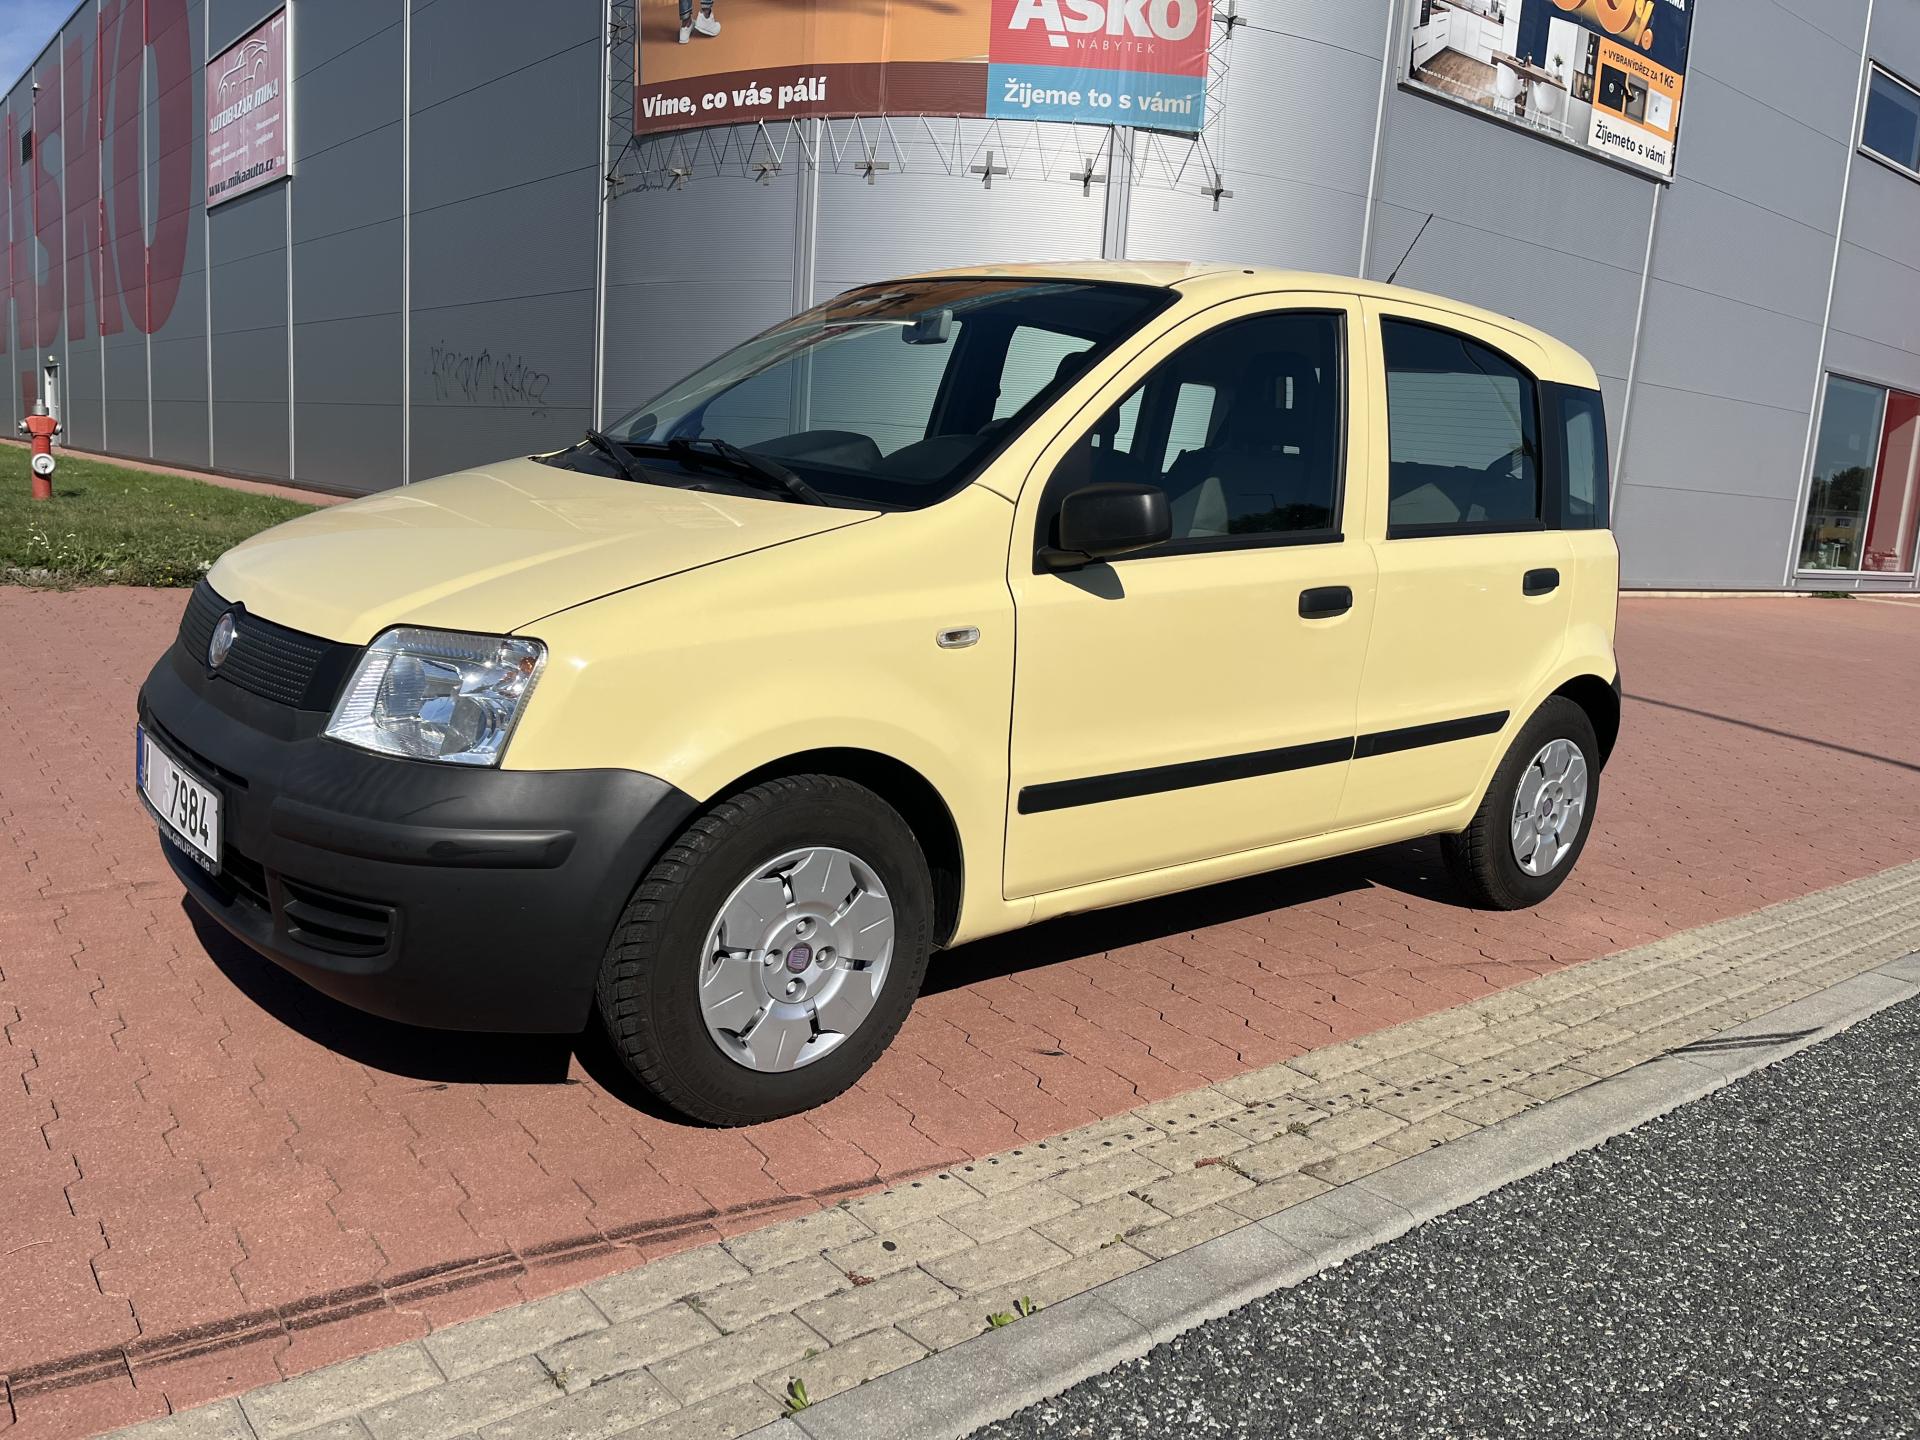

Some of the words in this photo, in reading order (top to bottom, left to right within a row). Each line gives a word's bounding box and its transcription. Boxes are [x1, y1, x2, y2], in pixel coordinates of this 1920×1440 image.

[1077, 37, 1155, 54] NÁBYTEK
[209, 94, 254, 136] AUTOBAZAR
[255, 78, 279, 109] MIKA
[642, 94, 697, 118] Víme,
[701, 92, 728, 110] co
[732, 81, 773, 107] vás
[778, 76, 827, 110] pálí
[1004, 77, 1081, 108] Žijeme
[1088, 88, 1112, 107] to
[1119, 94, 1131, 109] s
[1138, 91, 1191, 115] vámi
[1637, 144, 1643, 156] s
[1645, 145, 1666, 165] vámi
[208, 158, 274, 197] www.mikaauto.cz
[170, 768, 210, 849] 7984
